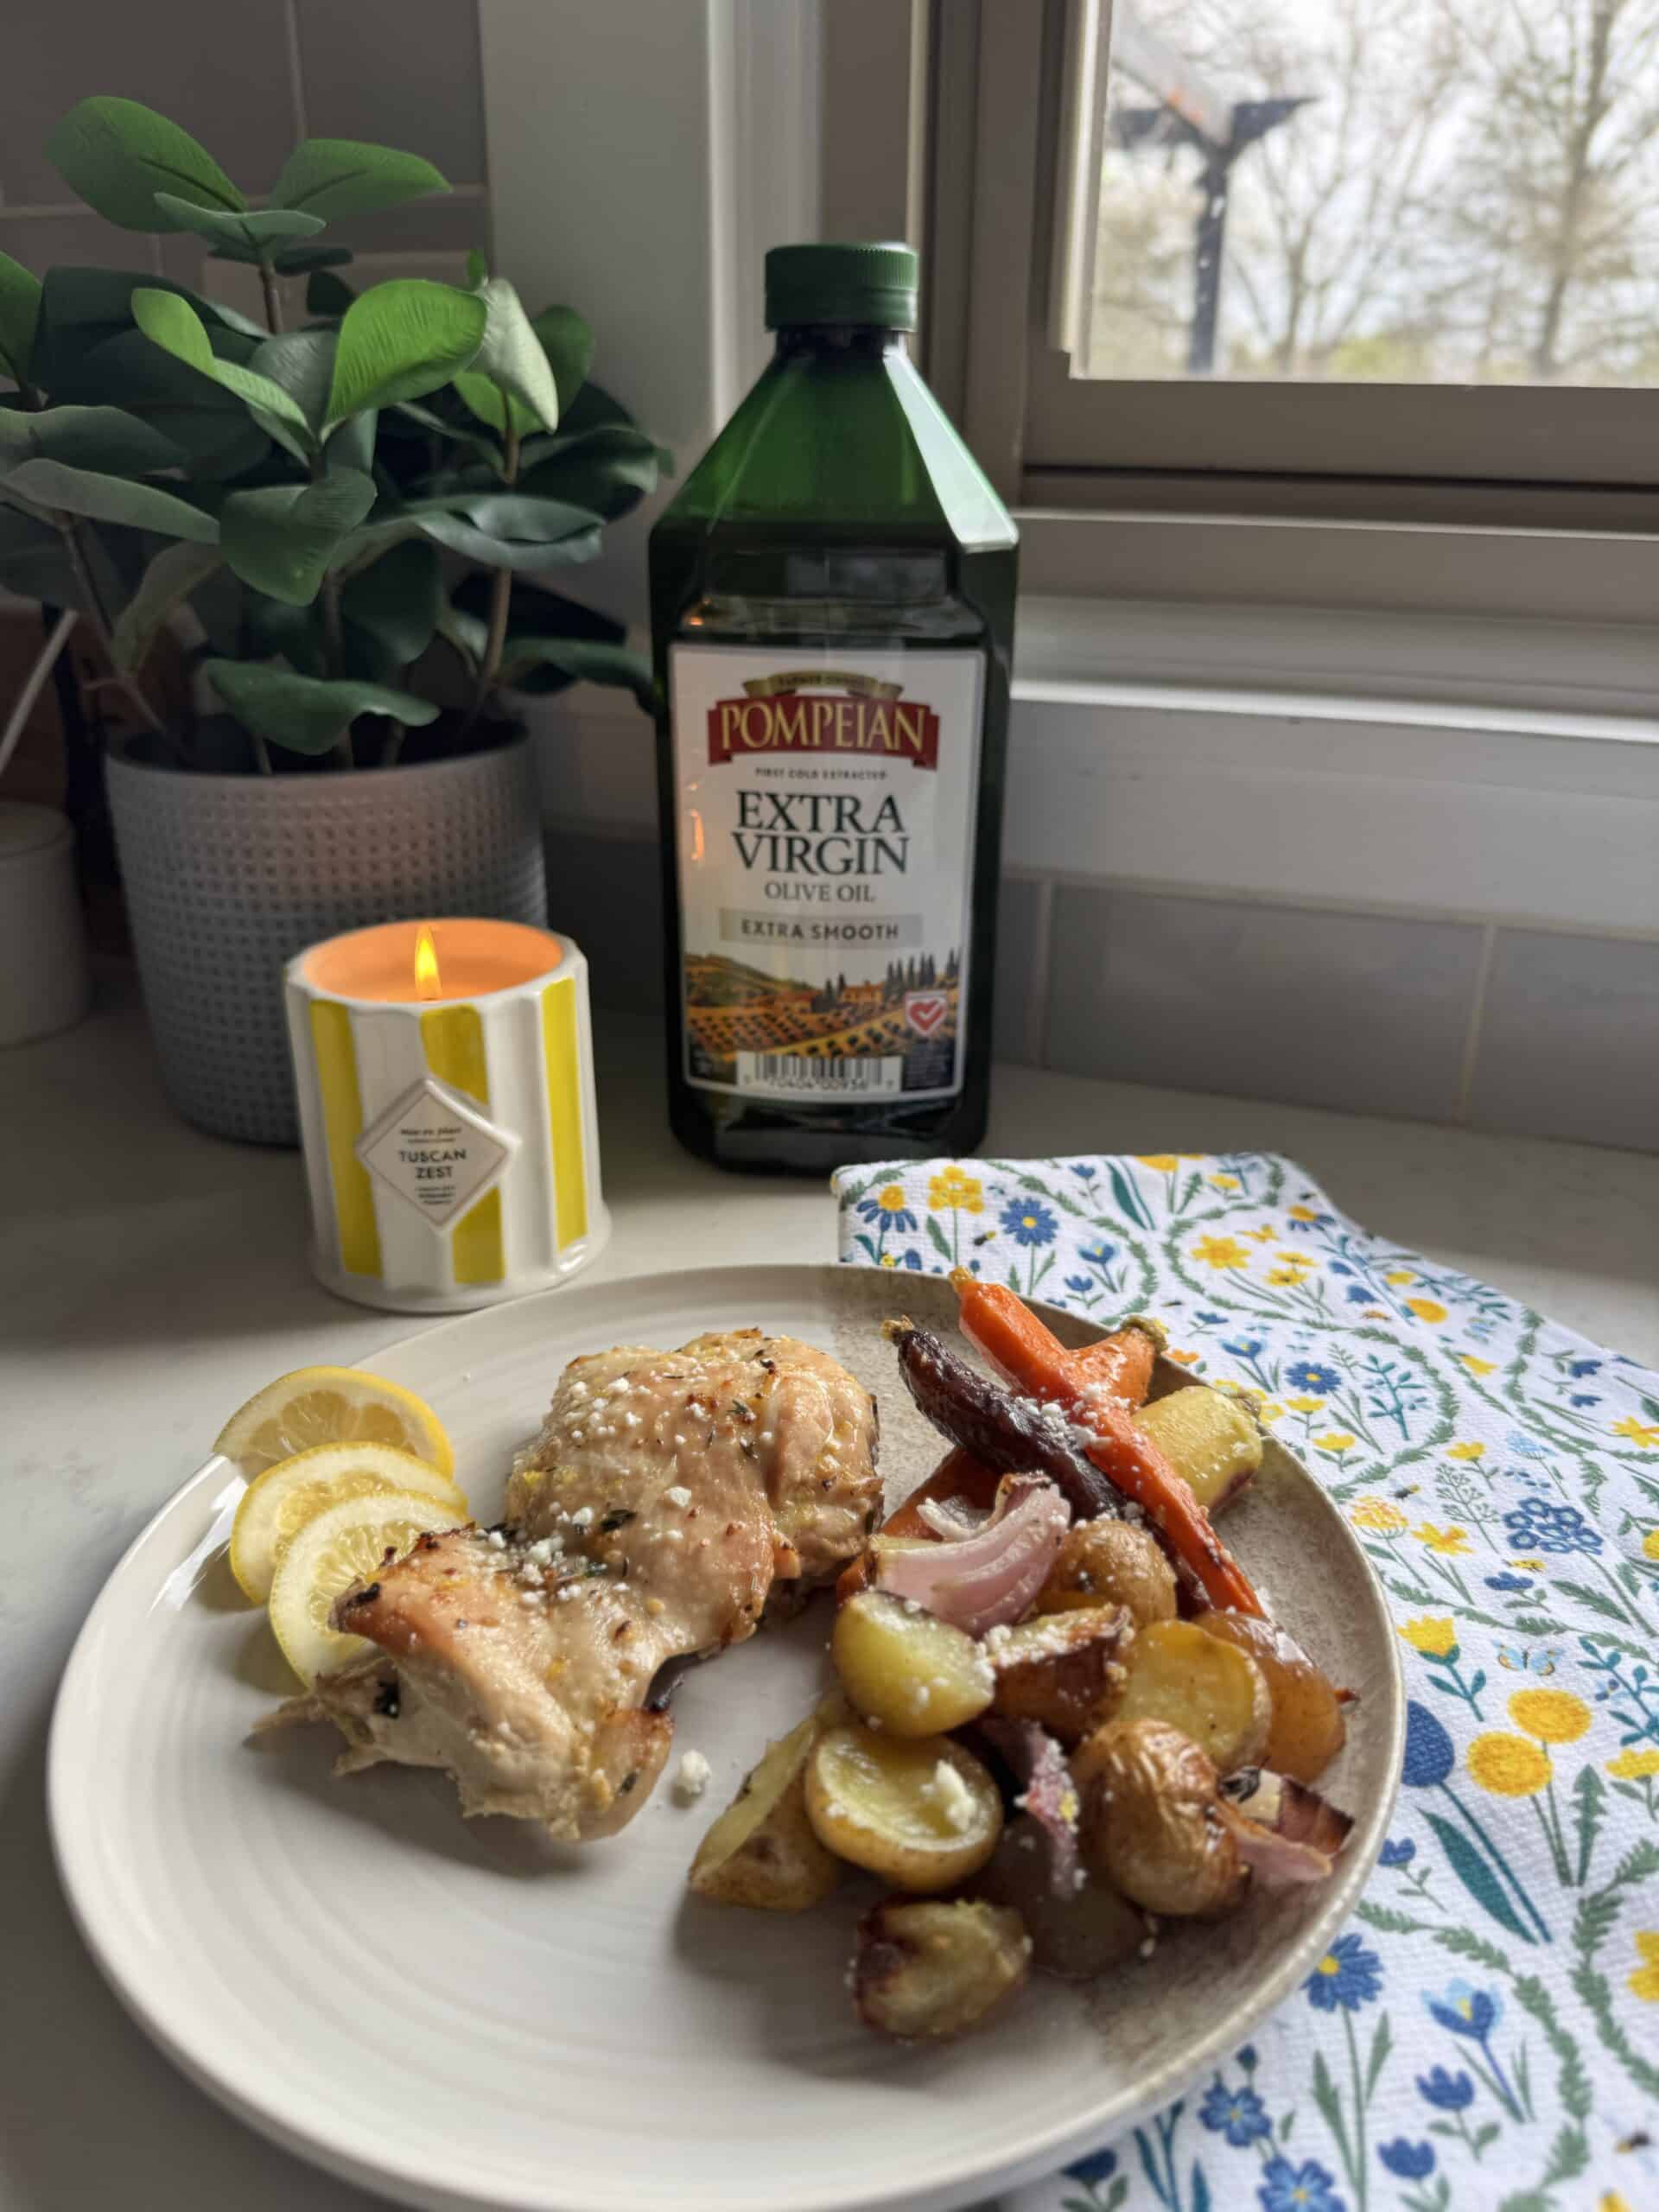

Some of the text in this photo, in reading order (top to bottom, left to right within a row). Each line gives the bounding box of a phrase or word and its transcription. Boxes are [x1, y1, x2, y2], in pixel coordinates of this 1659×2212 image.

[720, 701, 925, 752] POMPEIAN
[736, 790, 906, 834] EXTRA
[731, 831, 910, 876] VIRGIN
[765, 880, 876, 903] OLIVE OIL
[741, 918, 899, 941] EXTRA SMOOTH
[398, 1149, 467, 1163] TUSCAN
[415, 1165, 454, 1179] ZEST
